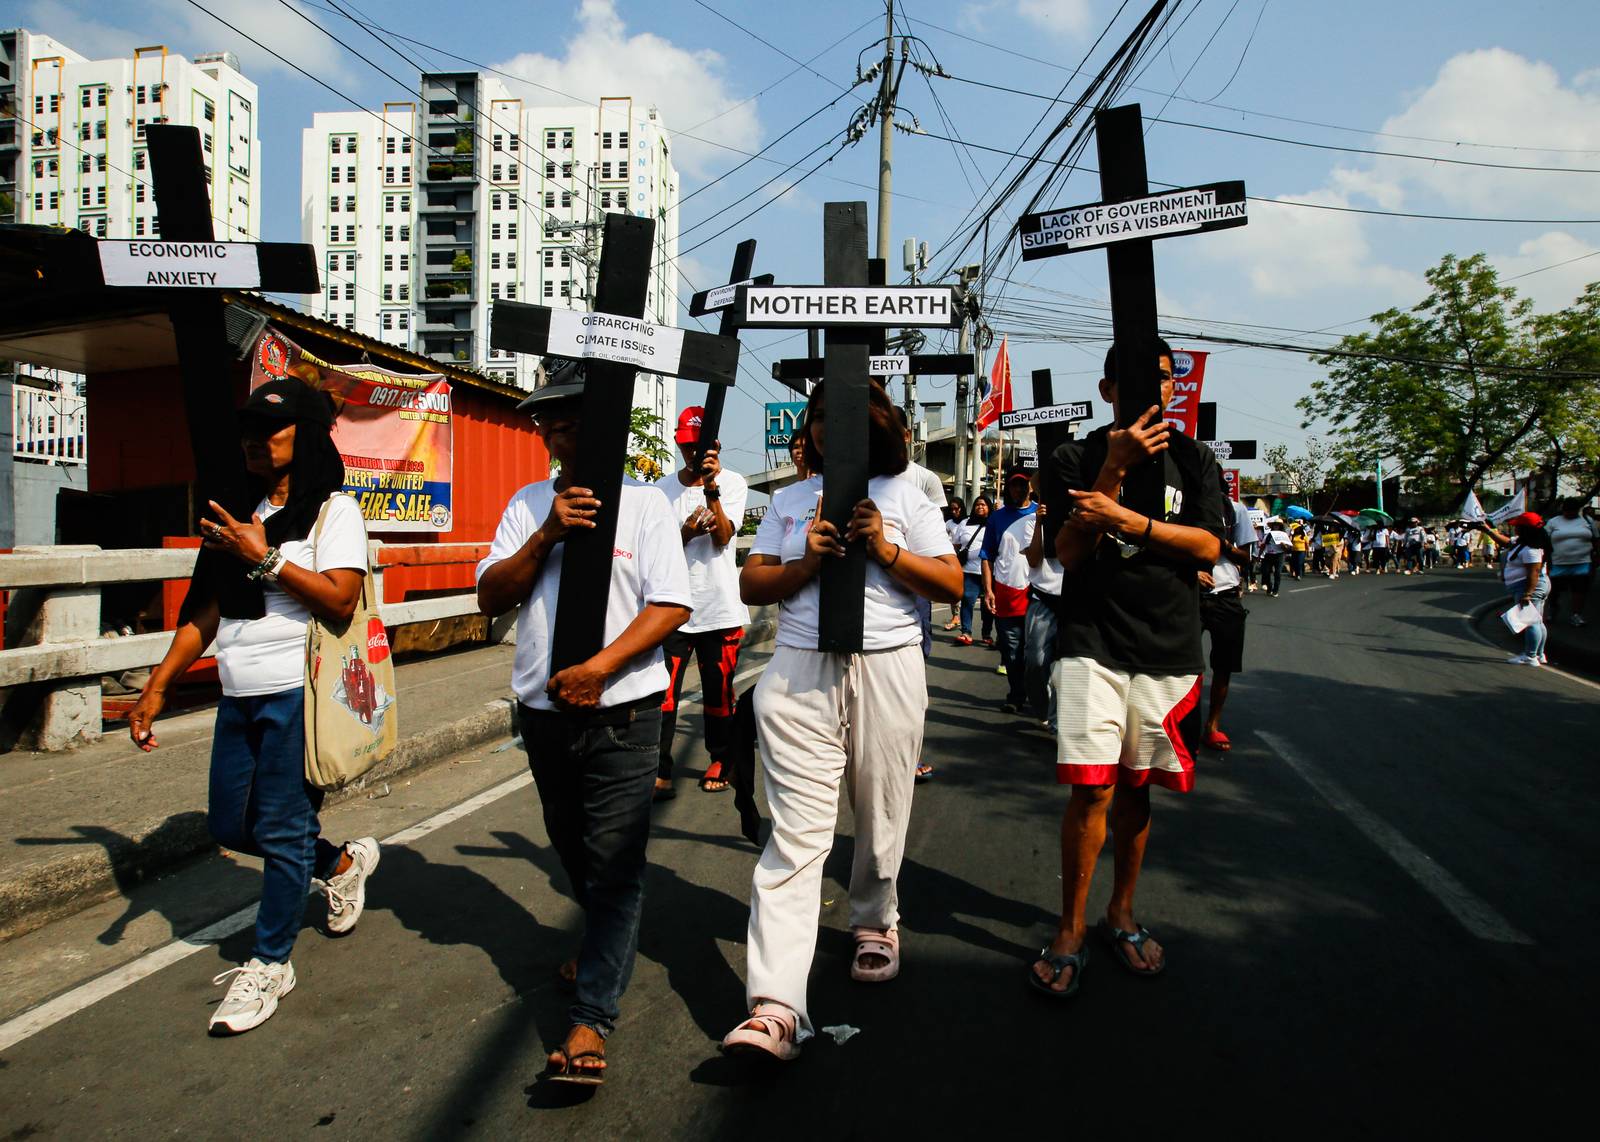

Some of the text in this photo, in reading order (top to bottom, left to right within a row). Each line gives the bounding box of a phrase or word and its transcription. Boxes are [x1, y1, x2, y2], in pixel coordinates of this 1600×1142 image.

[1042, 192, 1214, 230] LACK OF GOVERNMENT
[1024, 202, 1246, 247] SUPPORT VIS A VISBAYANIHAN
[129, 243, 227, 258] ECONOMIC
[146, 271, 217, 285] ANXIETY
[750, 295, 947, 315] MOTHER EARTH
[620, 340, 655, 356] ISSUES
[766, 408, 808, 431] HY
[1003, 406, 1085, 424] DISPLACEMENT
[768, 434, 792, 445] RES
[359, 491, 432, 522] FIRE SAFE
